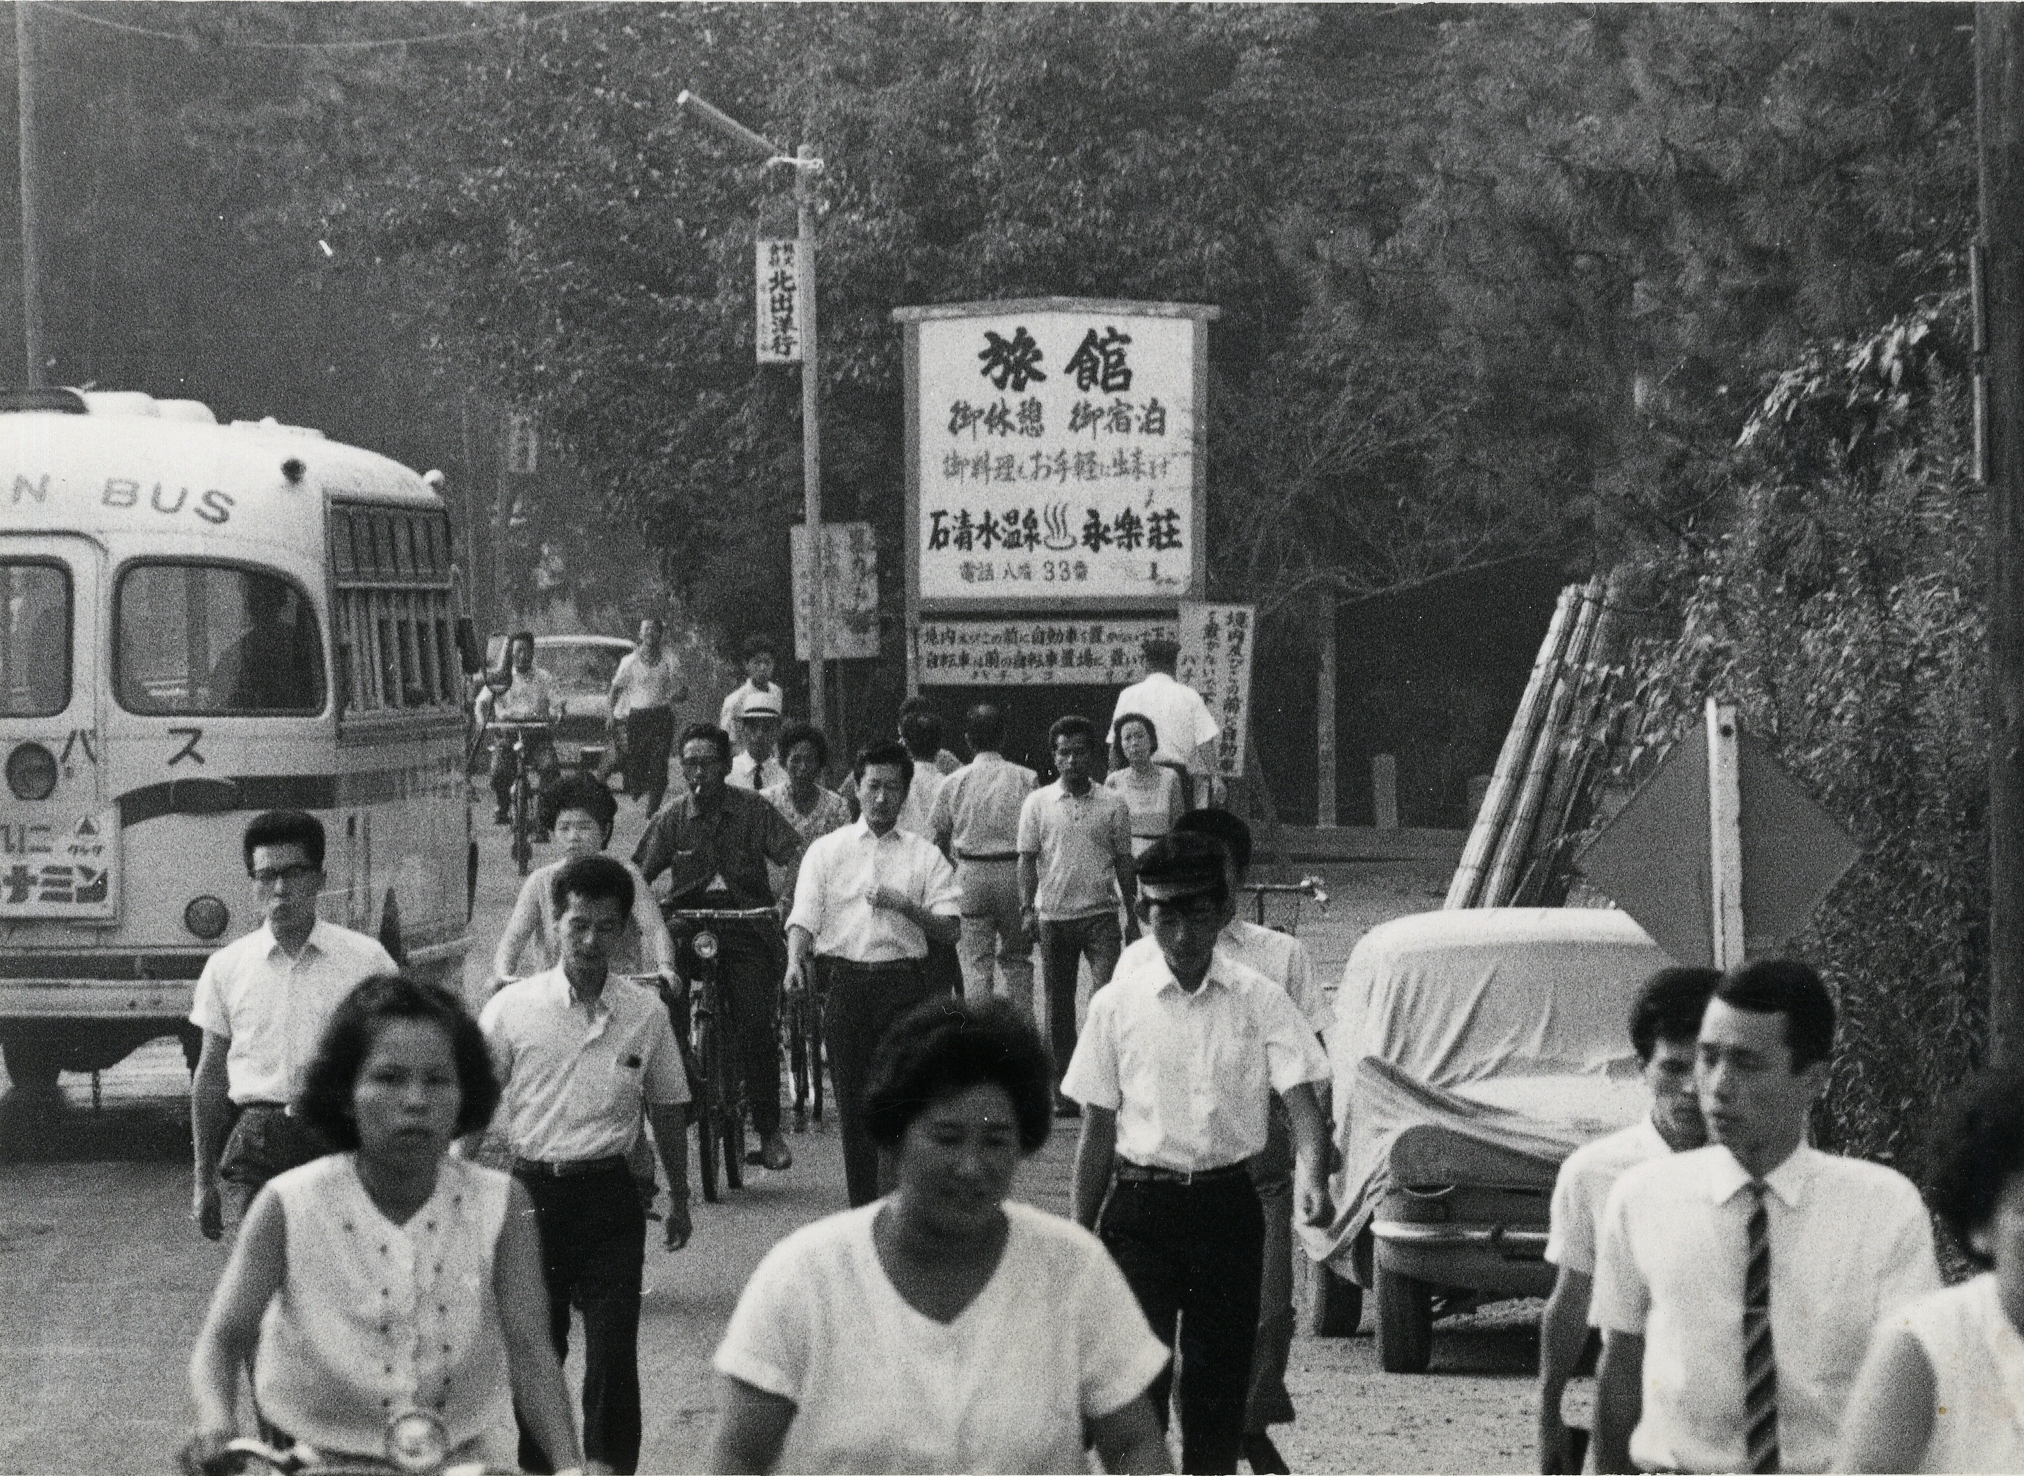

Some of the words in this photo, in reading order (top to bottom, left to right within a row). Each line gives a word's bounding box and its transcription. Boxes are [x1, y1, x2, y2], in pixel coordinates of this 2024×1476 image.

[978, 326, 1132, 393] 旅館
[948, 397, 1045, 440] 御休憩
[1068, 397, 1166, 440] 御宿泊
[12, 475, 50, 505] N
[101, 478, 236, 524] BUS
[929, 508, 1042, 552] 石清水温泉
